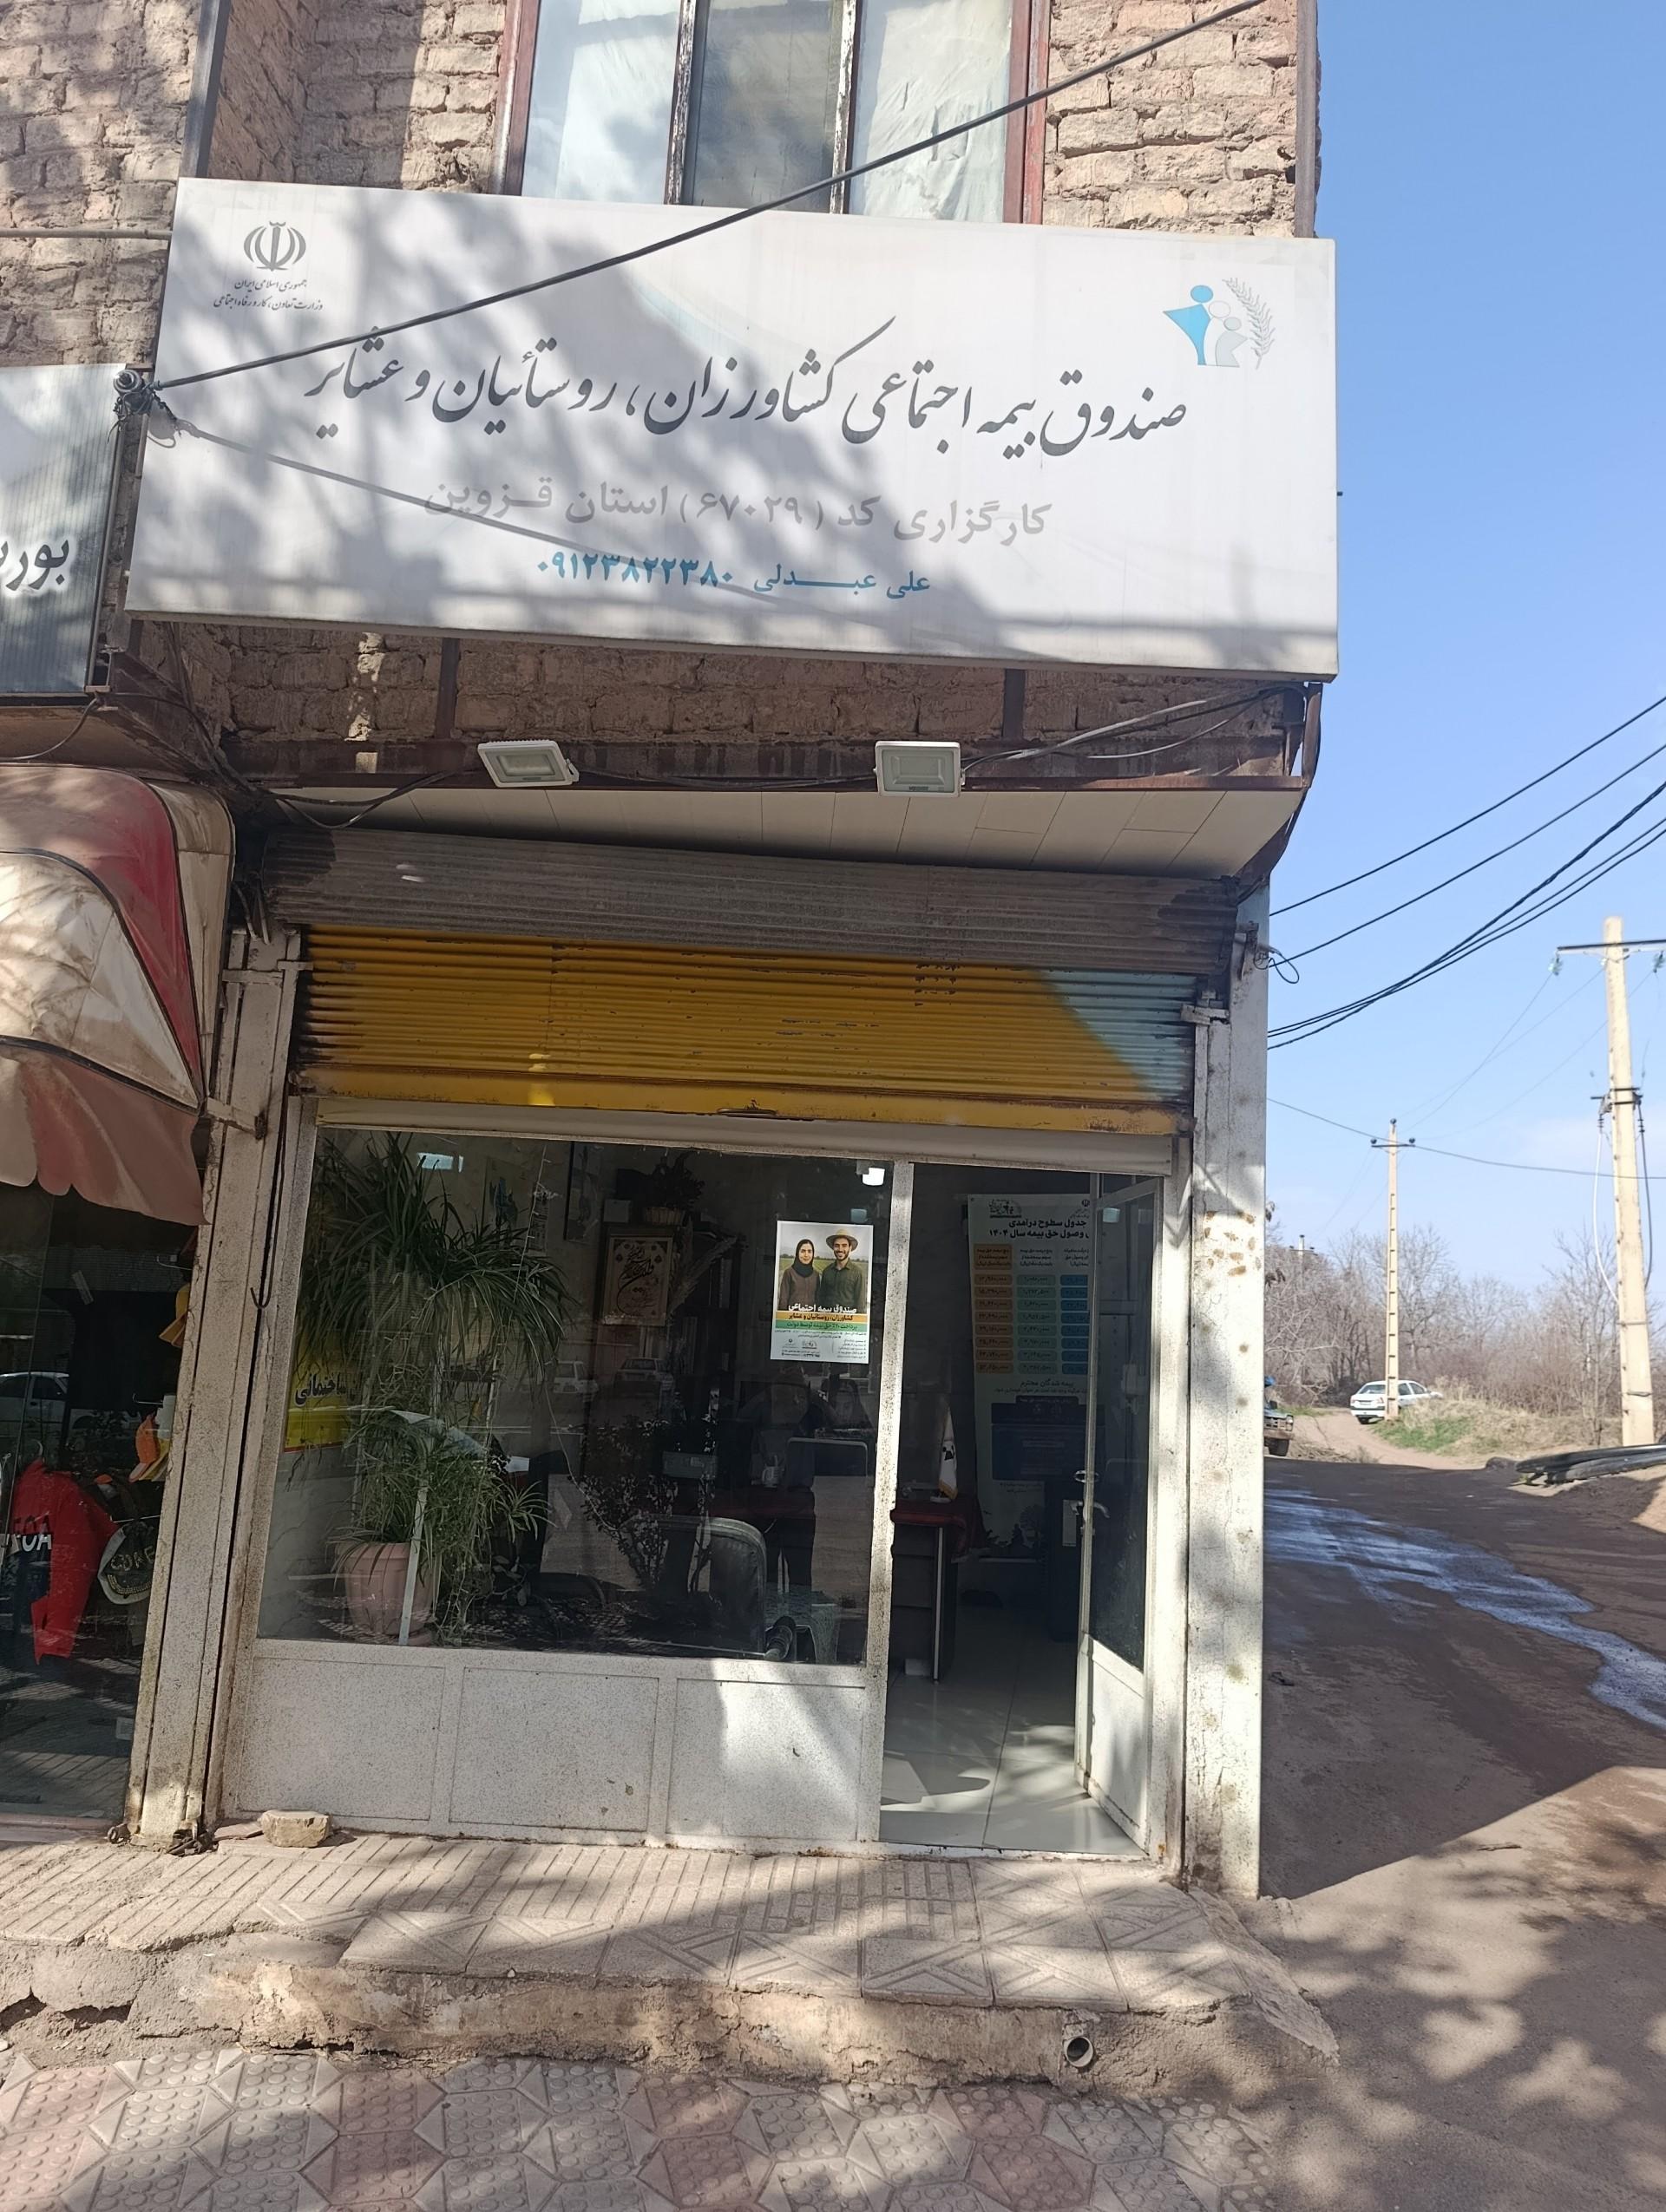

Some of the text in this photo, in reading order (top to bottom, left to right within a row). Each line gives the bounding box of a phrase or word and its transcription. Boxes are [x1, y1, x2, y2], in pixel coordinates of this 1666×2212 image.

[234, 279, 308, 292] جمهوری اسلامی ایران
[213, 293, 237, 310] اجتماعی
[257, 295, 272, 307] کار
[293, 298, 324, 311] وزارت
[304, 326, 404, 439] عشایر
[404, 369, 430, 402] و
[841, 342, 973, 444] اجتماعی
[1040, 369, 1187, 456] صندوق
[976, 398, 1036, 460] بیمه
[423, 476, 553, 519] قزوین
[565, 481, 669, 523] استان
[837, 495, 882, 527] کد
[894, 500, 1053, 546] کارگزاری
[0, 540, 69, 591] بور
[537, 551, 931, 599] علی عبدلی ۰۹۱۲۳۸۲۲۳۸۰
[1010, 1229, 1026, 1238] سال
[1027, 1229, 1044, 1239] بیمه
[1038, 1218, 1062, 1228] سطوح
[1045, 1229, 1059, 1238] حق
[1060, 1229, 1084, 1239] وصول
[1065, 1218, 1086, 1228] جدول
[834, 1304, 857, 1313] صندوق
